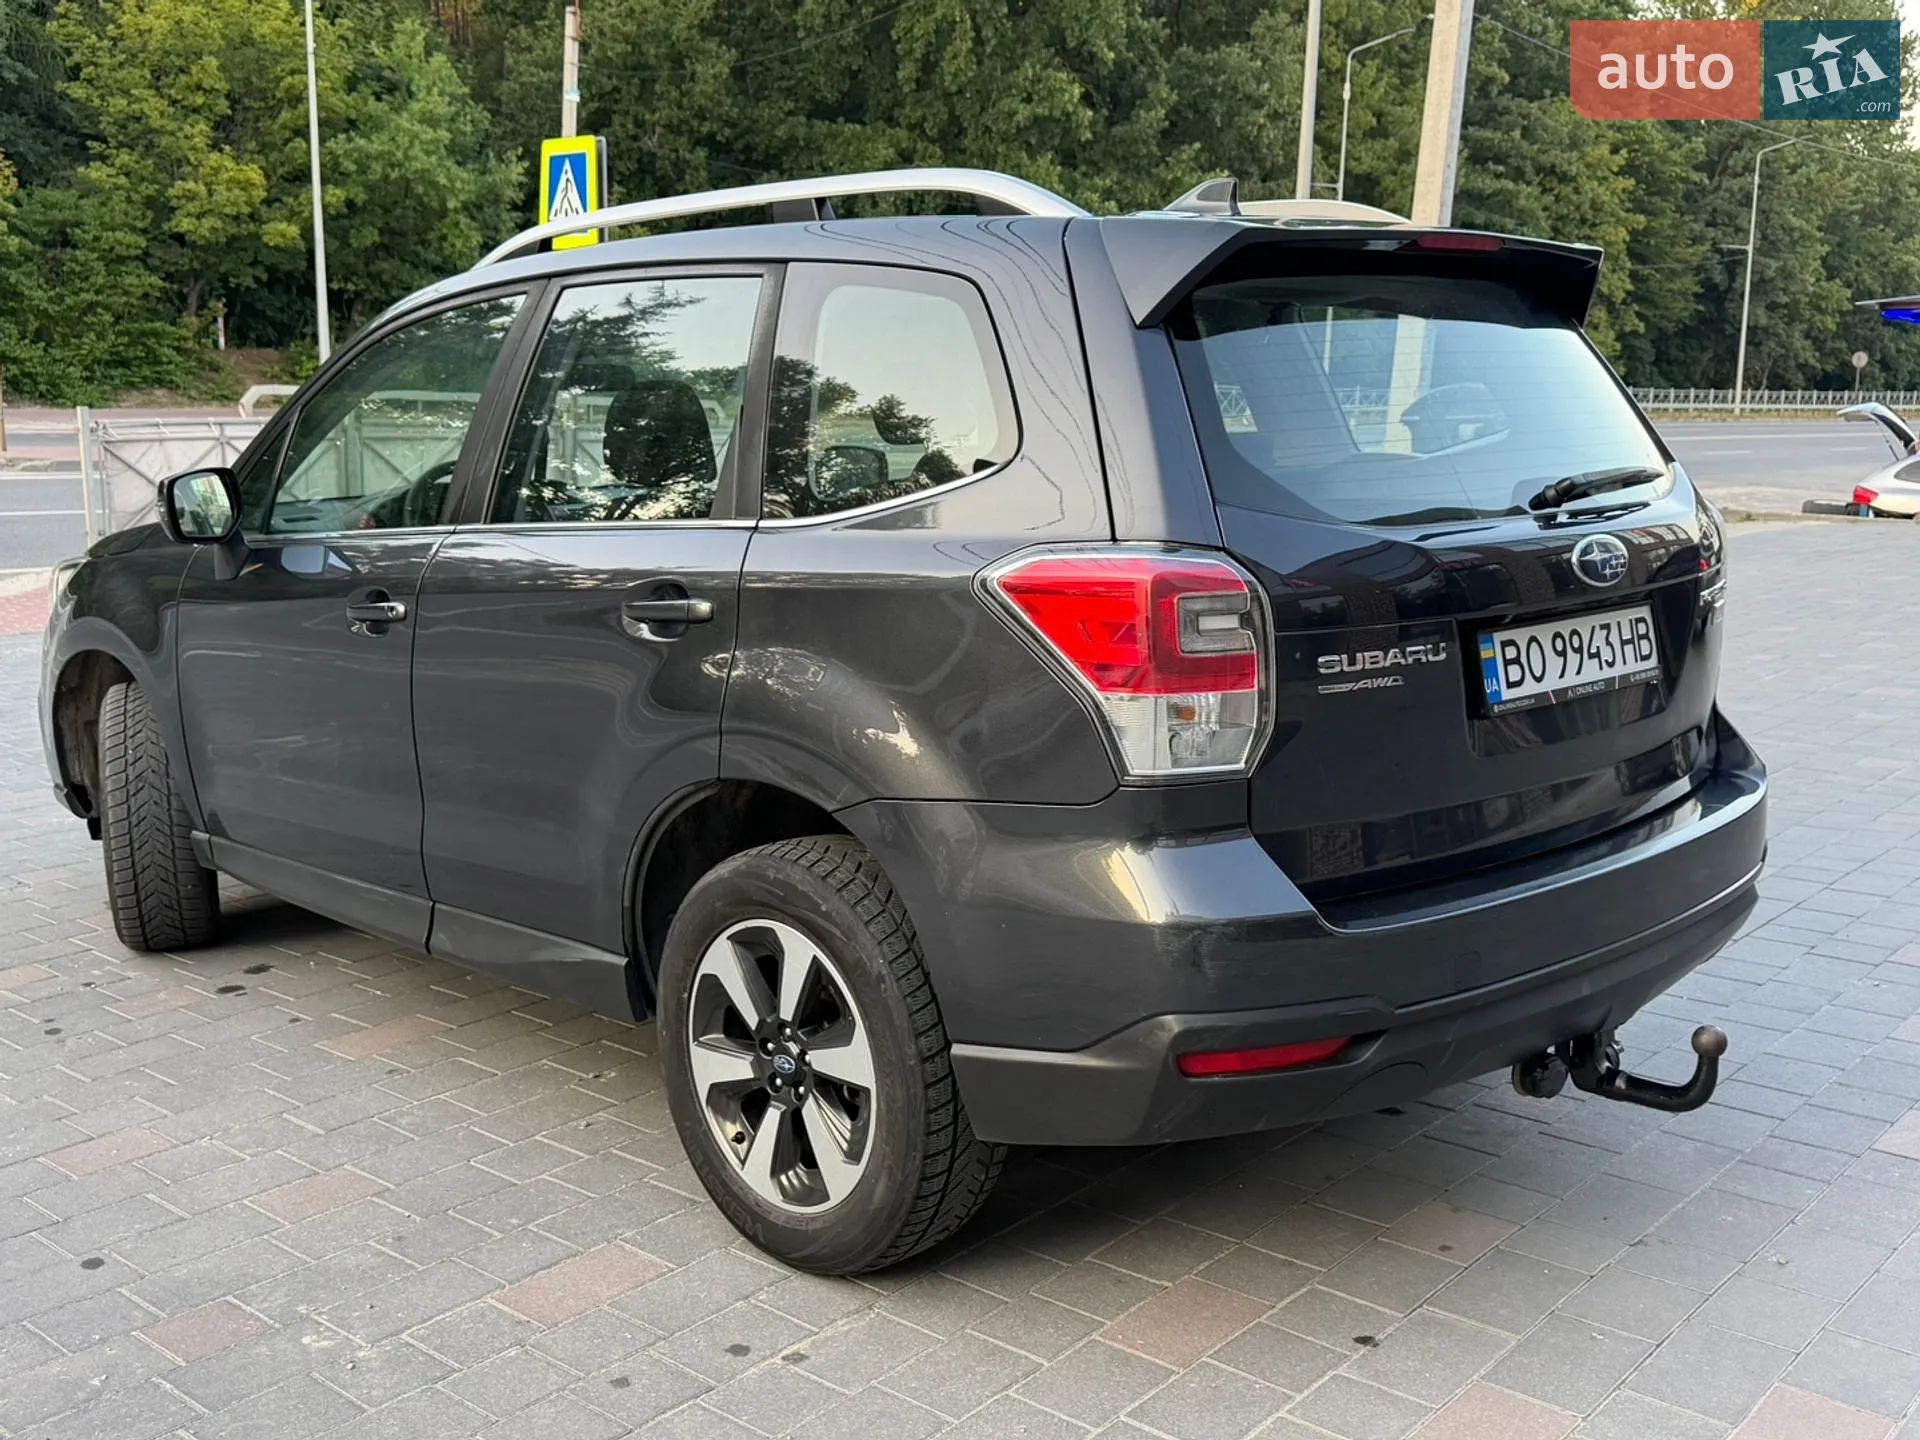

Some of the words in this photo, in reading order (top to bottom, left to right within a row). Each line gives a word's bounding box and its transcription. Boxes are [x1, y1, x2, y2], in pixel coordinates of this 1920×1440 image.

[1317, 642, 1447, 675] SUBARU
[1500, 634, 1547, 690] BO
[1550, 622, 1616, 680] 9943
[1616, 615, 1654, 667] HB
[1351, 675, 1405, 691] AWD
[1484, 677, 1500, 694] UA
